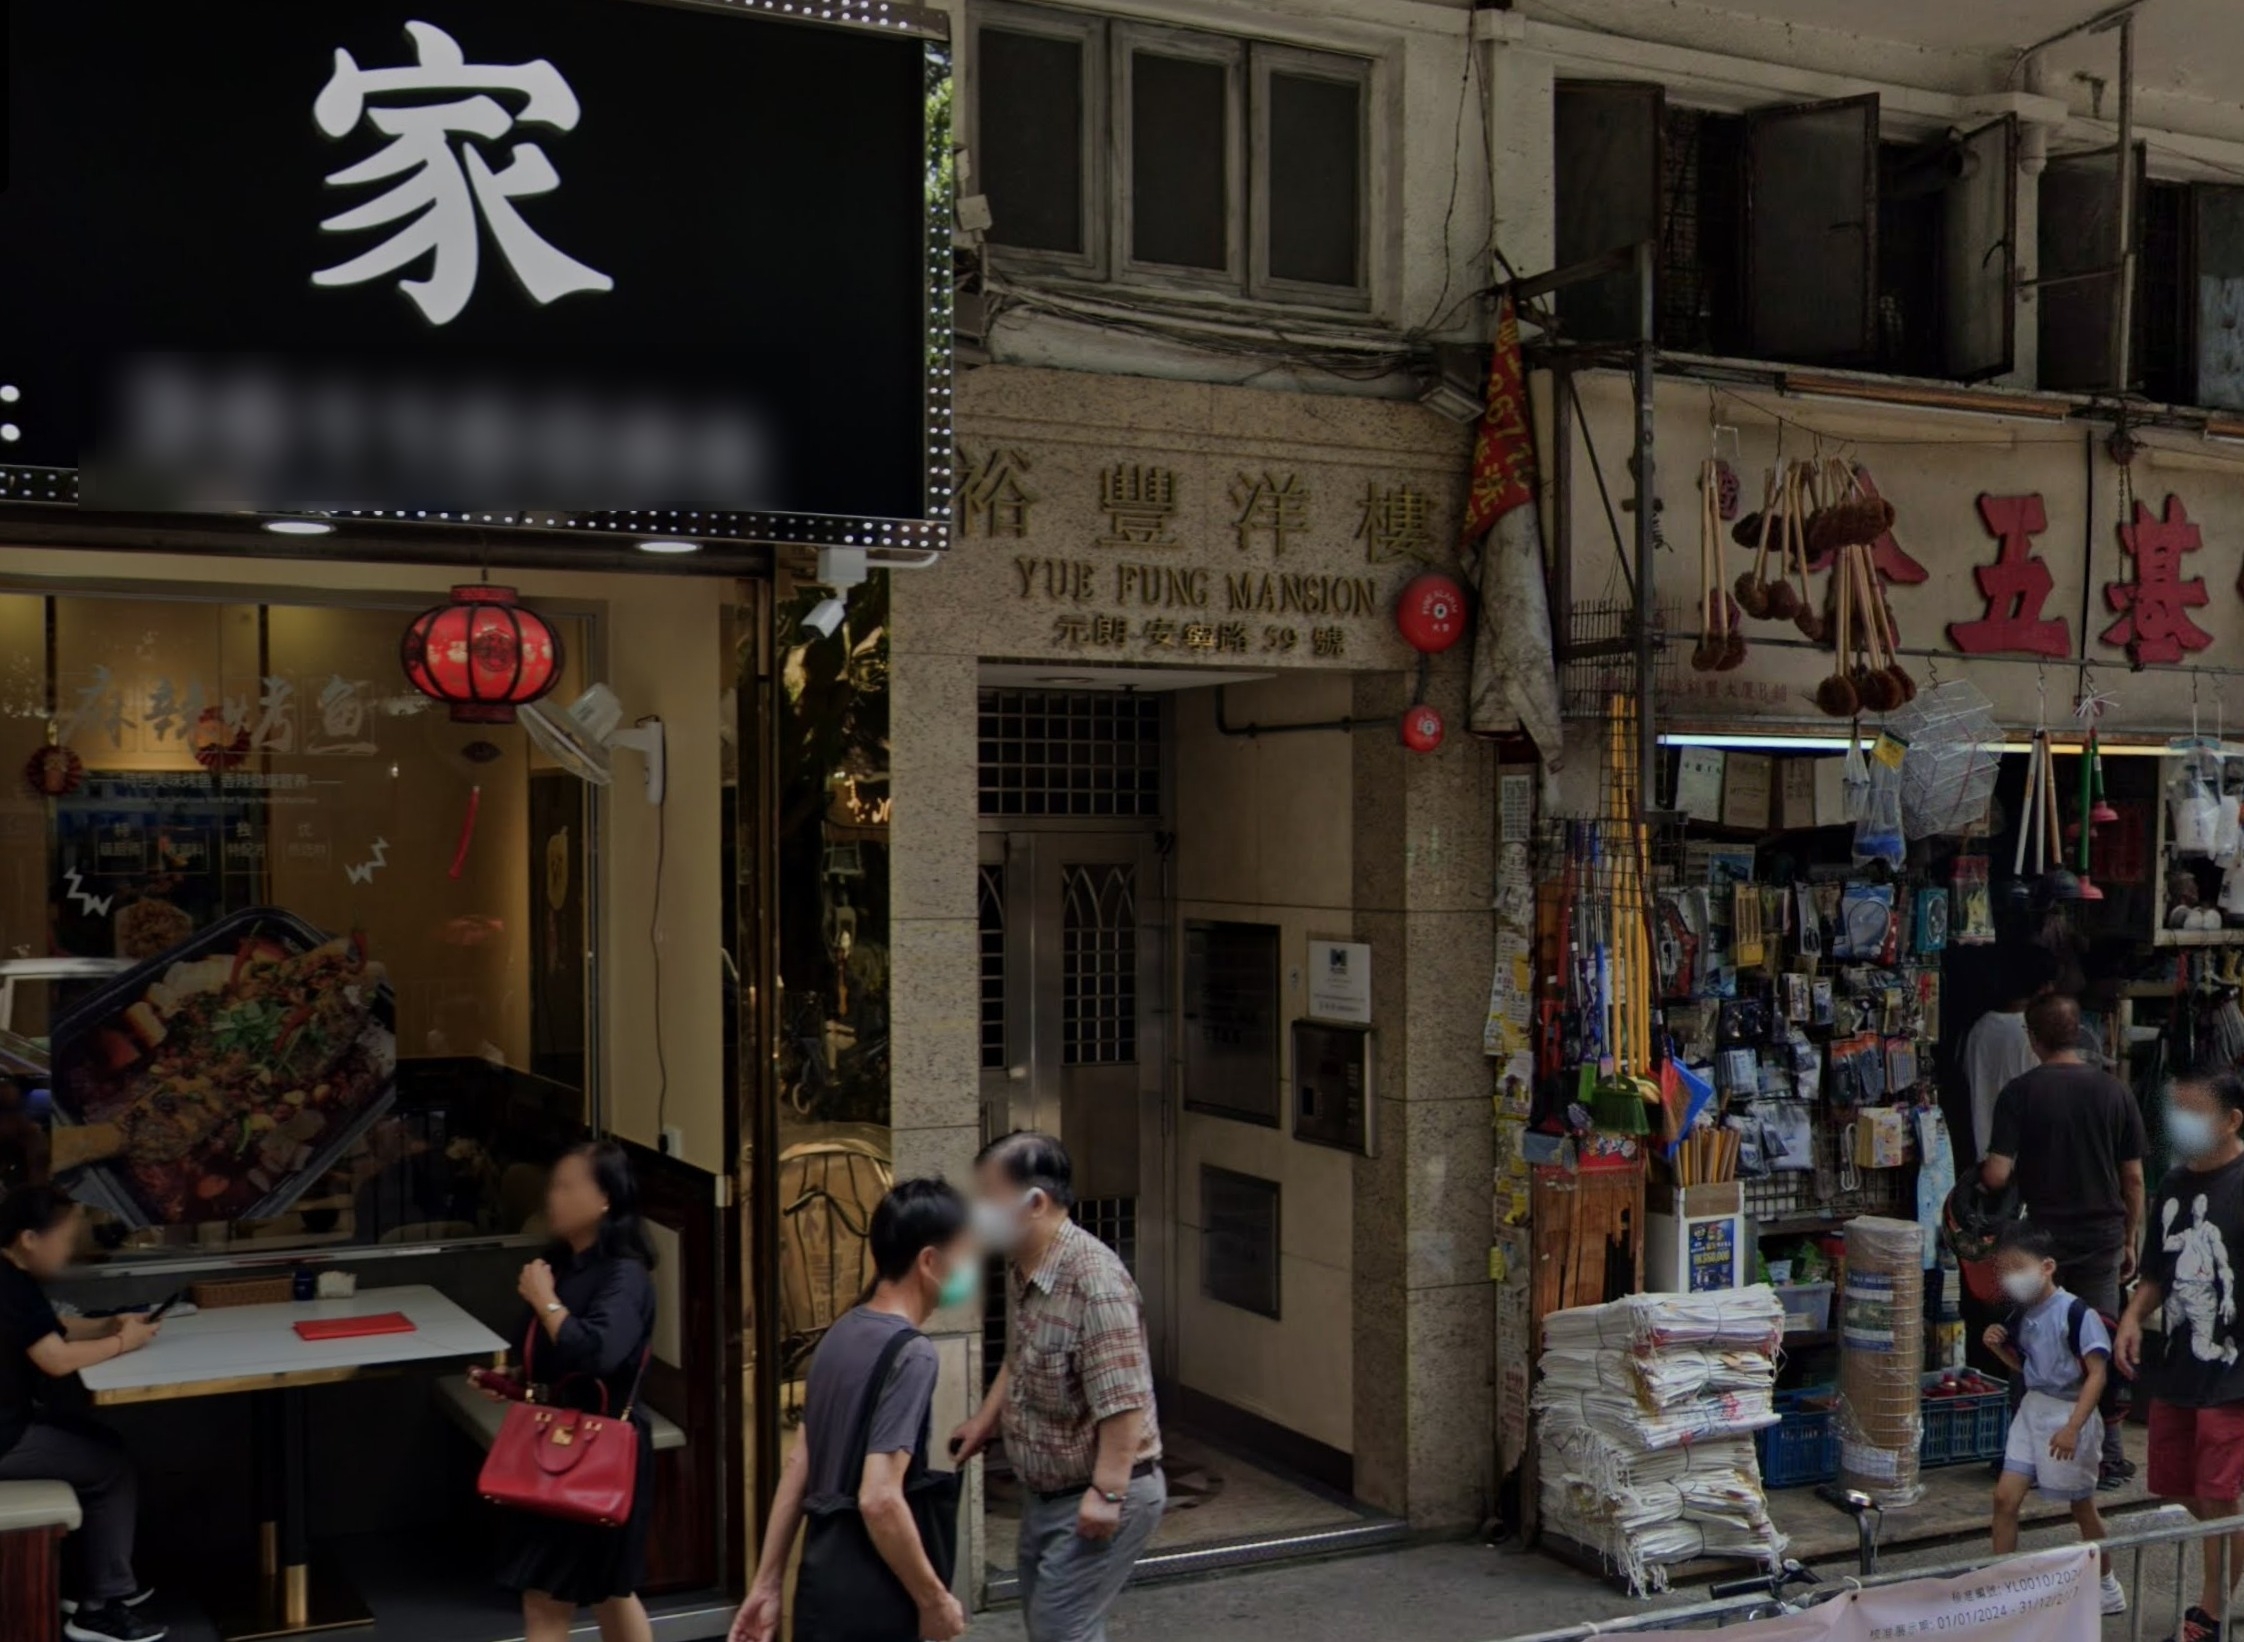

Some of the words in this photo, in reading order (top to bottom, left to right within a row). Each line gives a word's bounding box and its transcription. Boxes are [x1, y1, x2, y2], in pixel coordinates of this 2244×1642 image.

[311, 19, 614, 326] 家
[954, 446, 1438, 566] 裕豐洋樓
[1015, 556, 1095, 603] YUE
[1117, 563, 1209, 608] FUNG
[1226, 571, 1376, 617] MANSION
[1937, 1603, 2007, 1629] 01/01/2024
